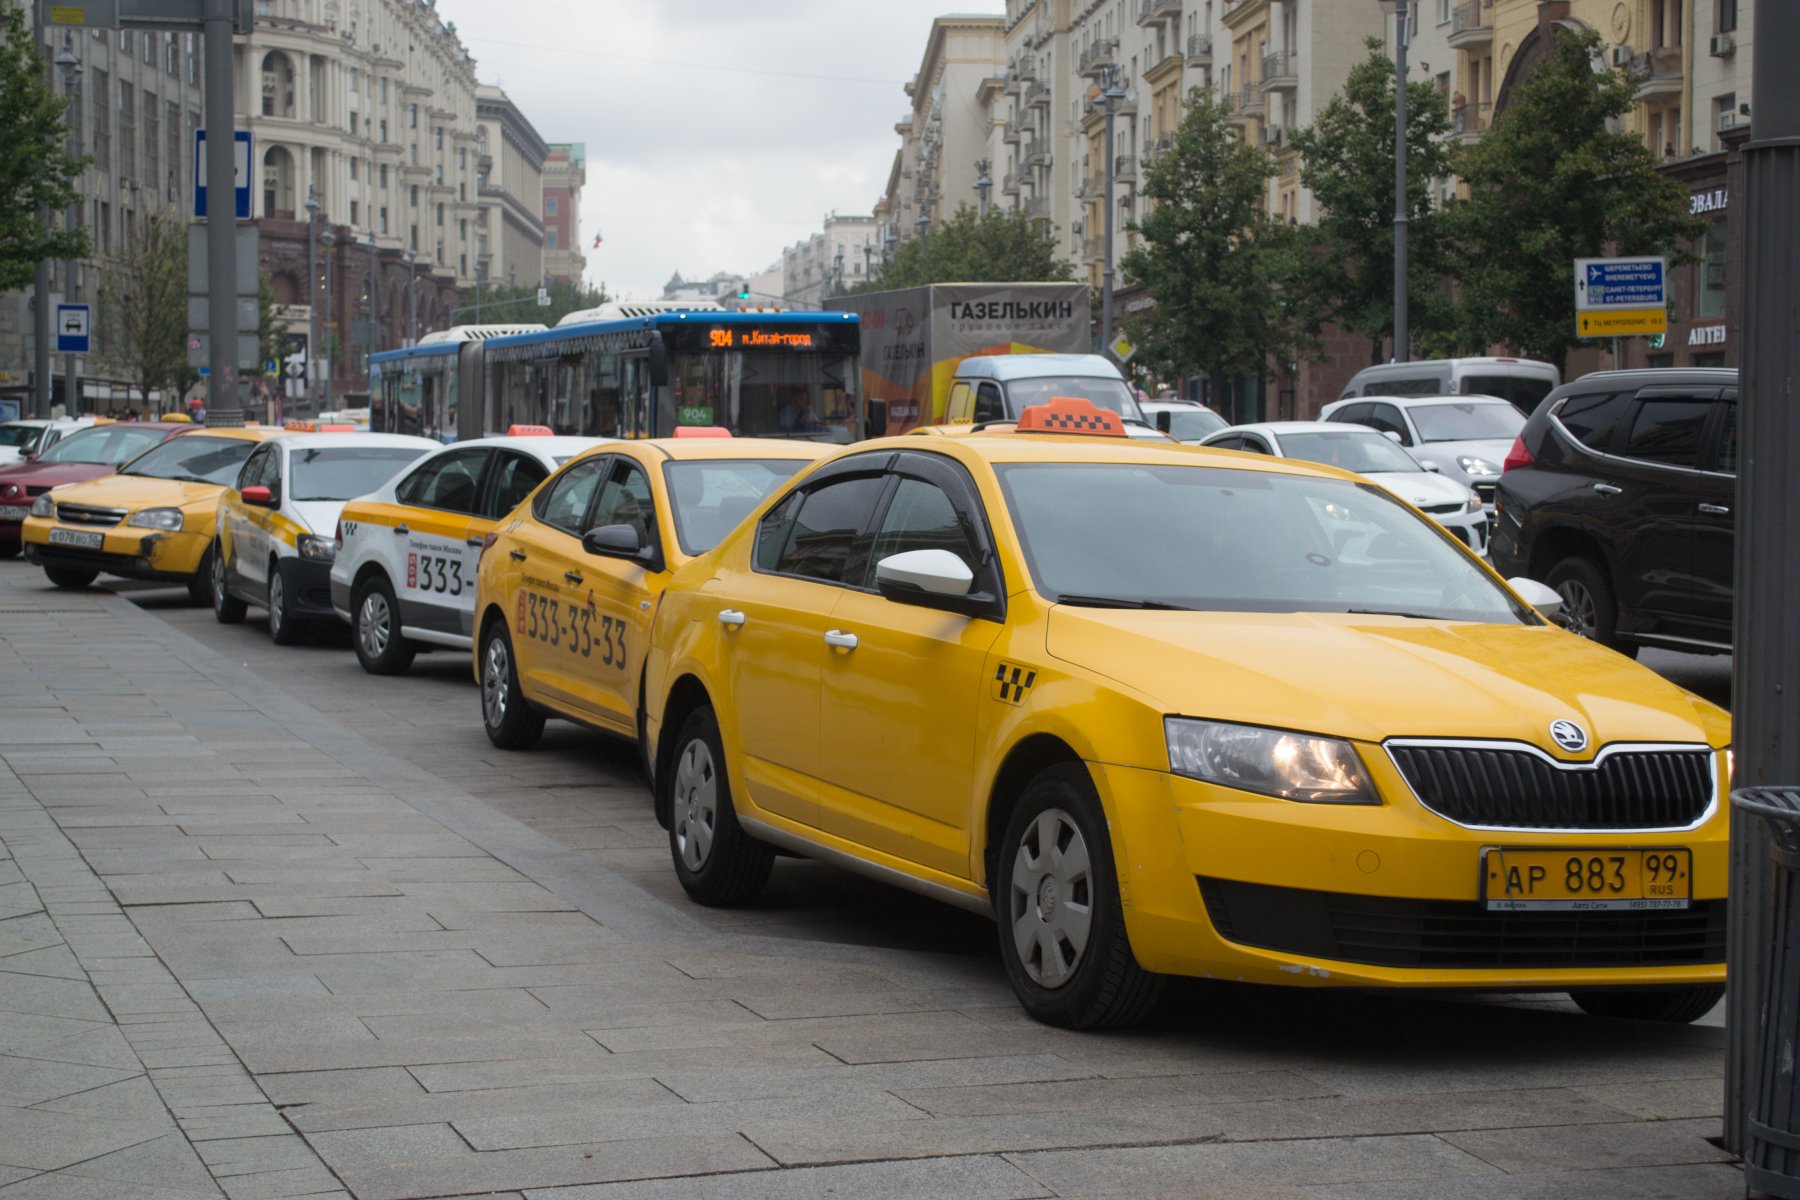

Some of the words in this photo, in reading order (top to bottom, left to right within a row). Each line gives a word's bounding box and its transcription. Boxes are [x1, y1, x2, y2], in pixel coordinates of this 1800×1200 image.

[951, 302, 1072, 319] ГАЗЕЛЬКИН
[709, 329, 732, 347] 904
[683, 408, 706, 419] 904
[420, 555, 480, 596] 333-
[528, 592, 627, 670] 333-33-33
[1565, 856, 1626, 894] 883
[1646, 854, 1679, 883] 99
[1650, 884, 1674, 896] RUS
